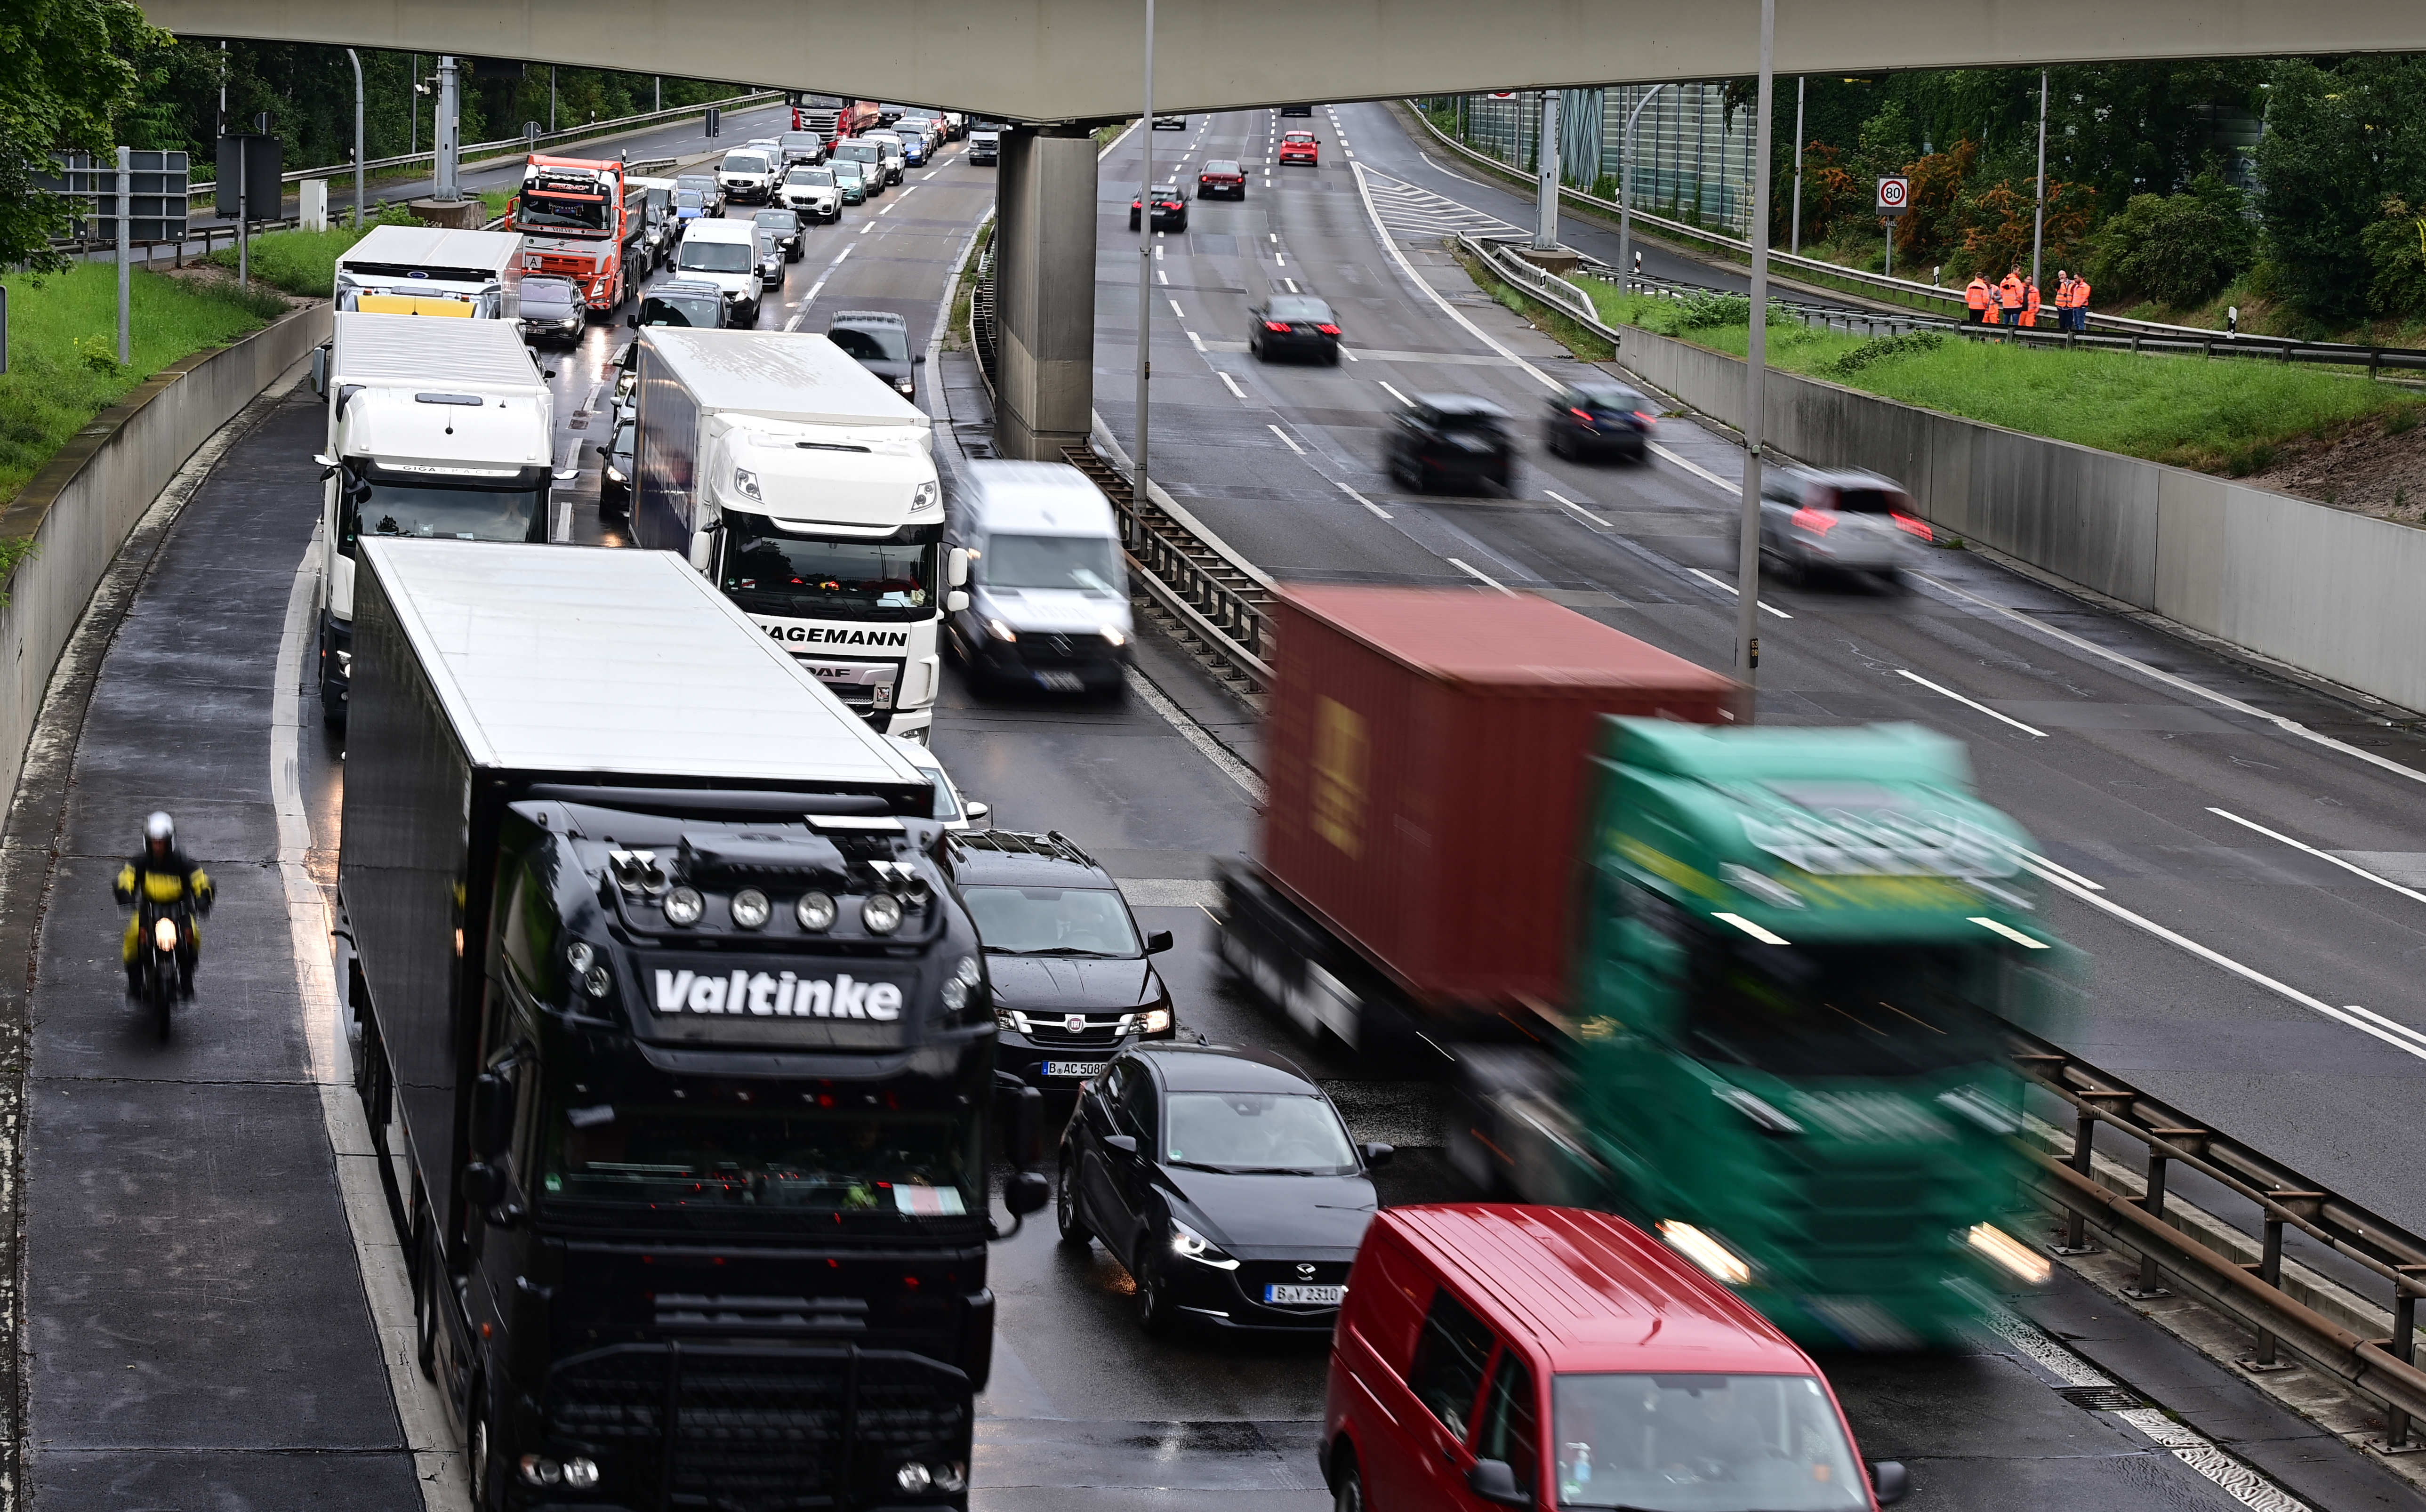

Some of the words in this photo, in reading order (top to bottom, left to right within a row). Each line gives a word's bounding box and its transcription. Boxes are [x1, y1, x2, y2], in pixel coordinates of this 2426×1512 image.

[1886, 187, 1900, 199] 80
[530, 257, 537, 266] A
[655, 969, 903, 1021] Valtinke
[1049, 1063, 1056, 1073] B
[1064, 1064, 1077, 1074] AC
[1277, 1287, 1286, 1299] B
